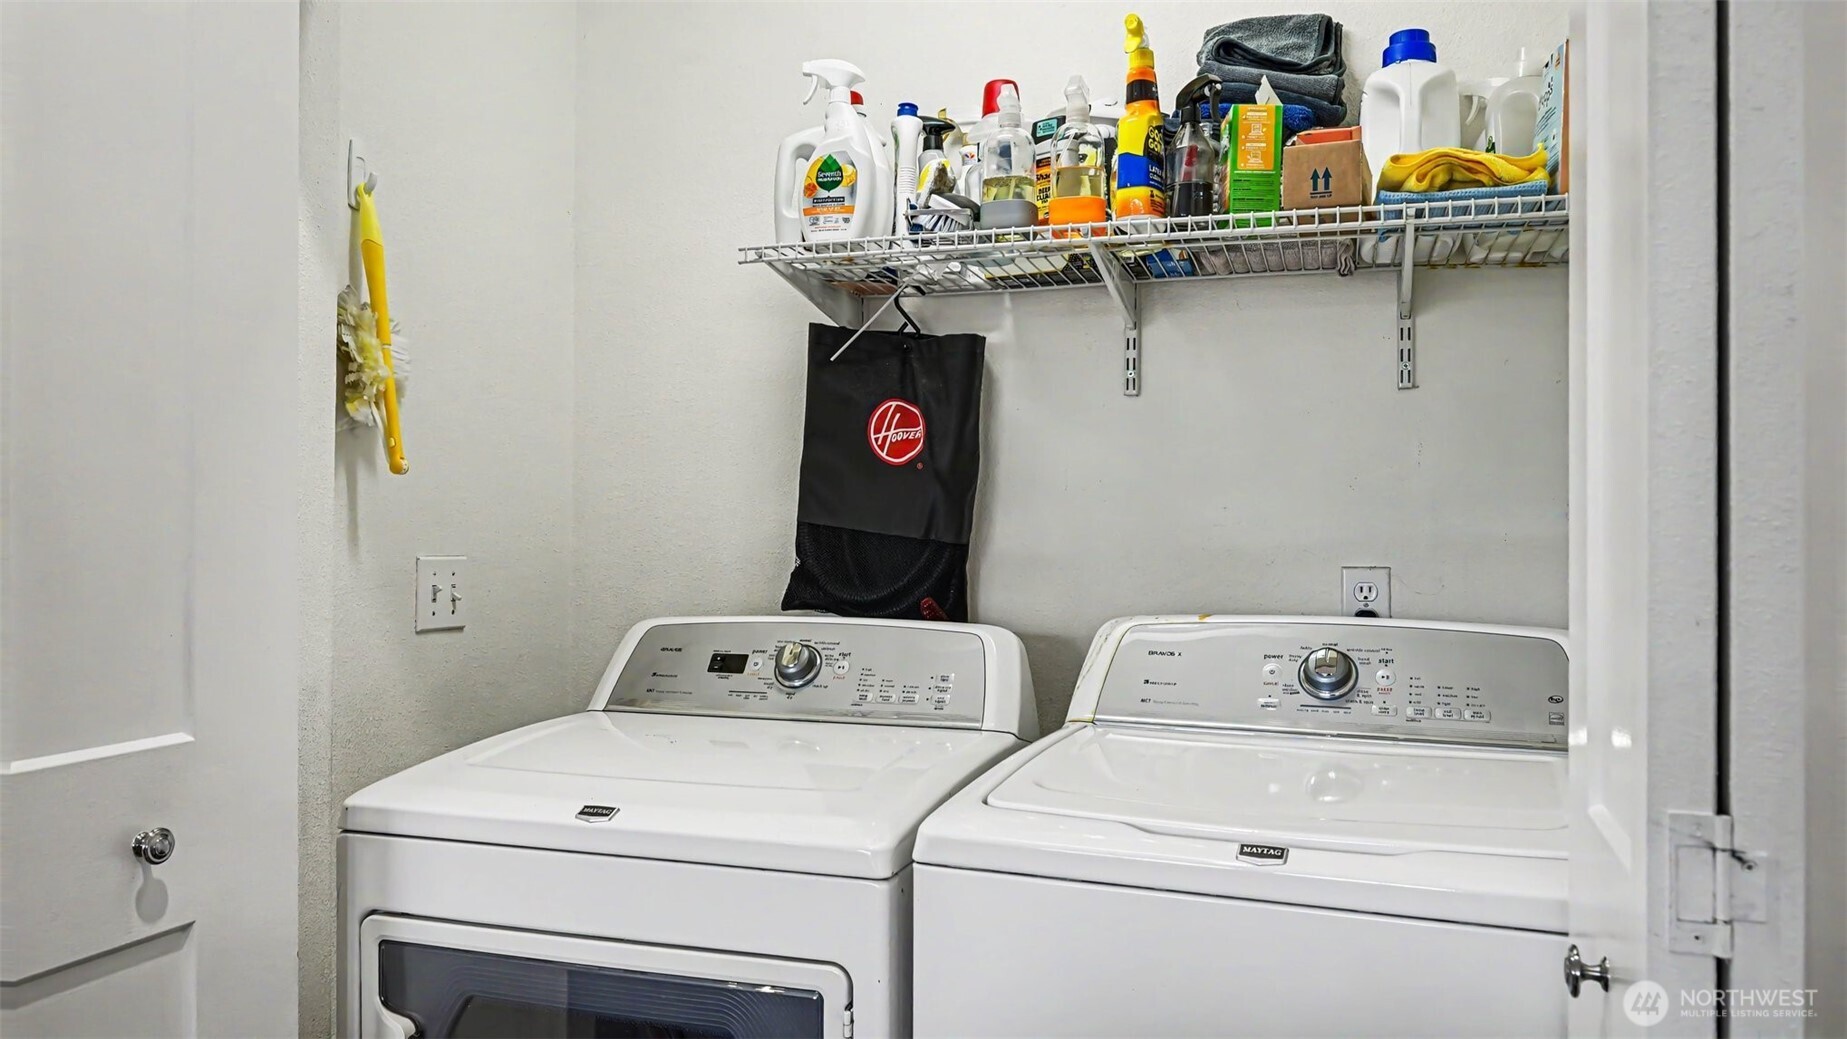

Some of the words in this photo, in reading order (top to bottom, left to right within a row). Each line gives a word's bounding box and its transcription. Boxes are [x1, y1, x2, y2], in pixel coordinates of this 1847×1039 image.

[872, 402, 921, 456] HOOVER
[583, 807, 613, 815] MAYTAG
[1242, 846, 1283, 856] MAYTAG
